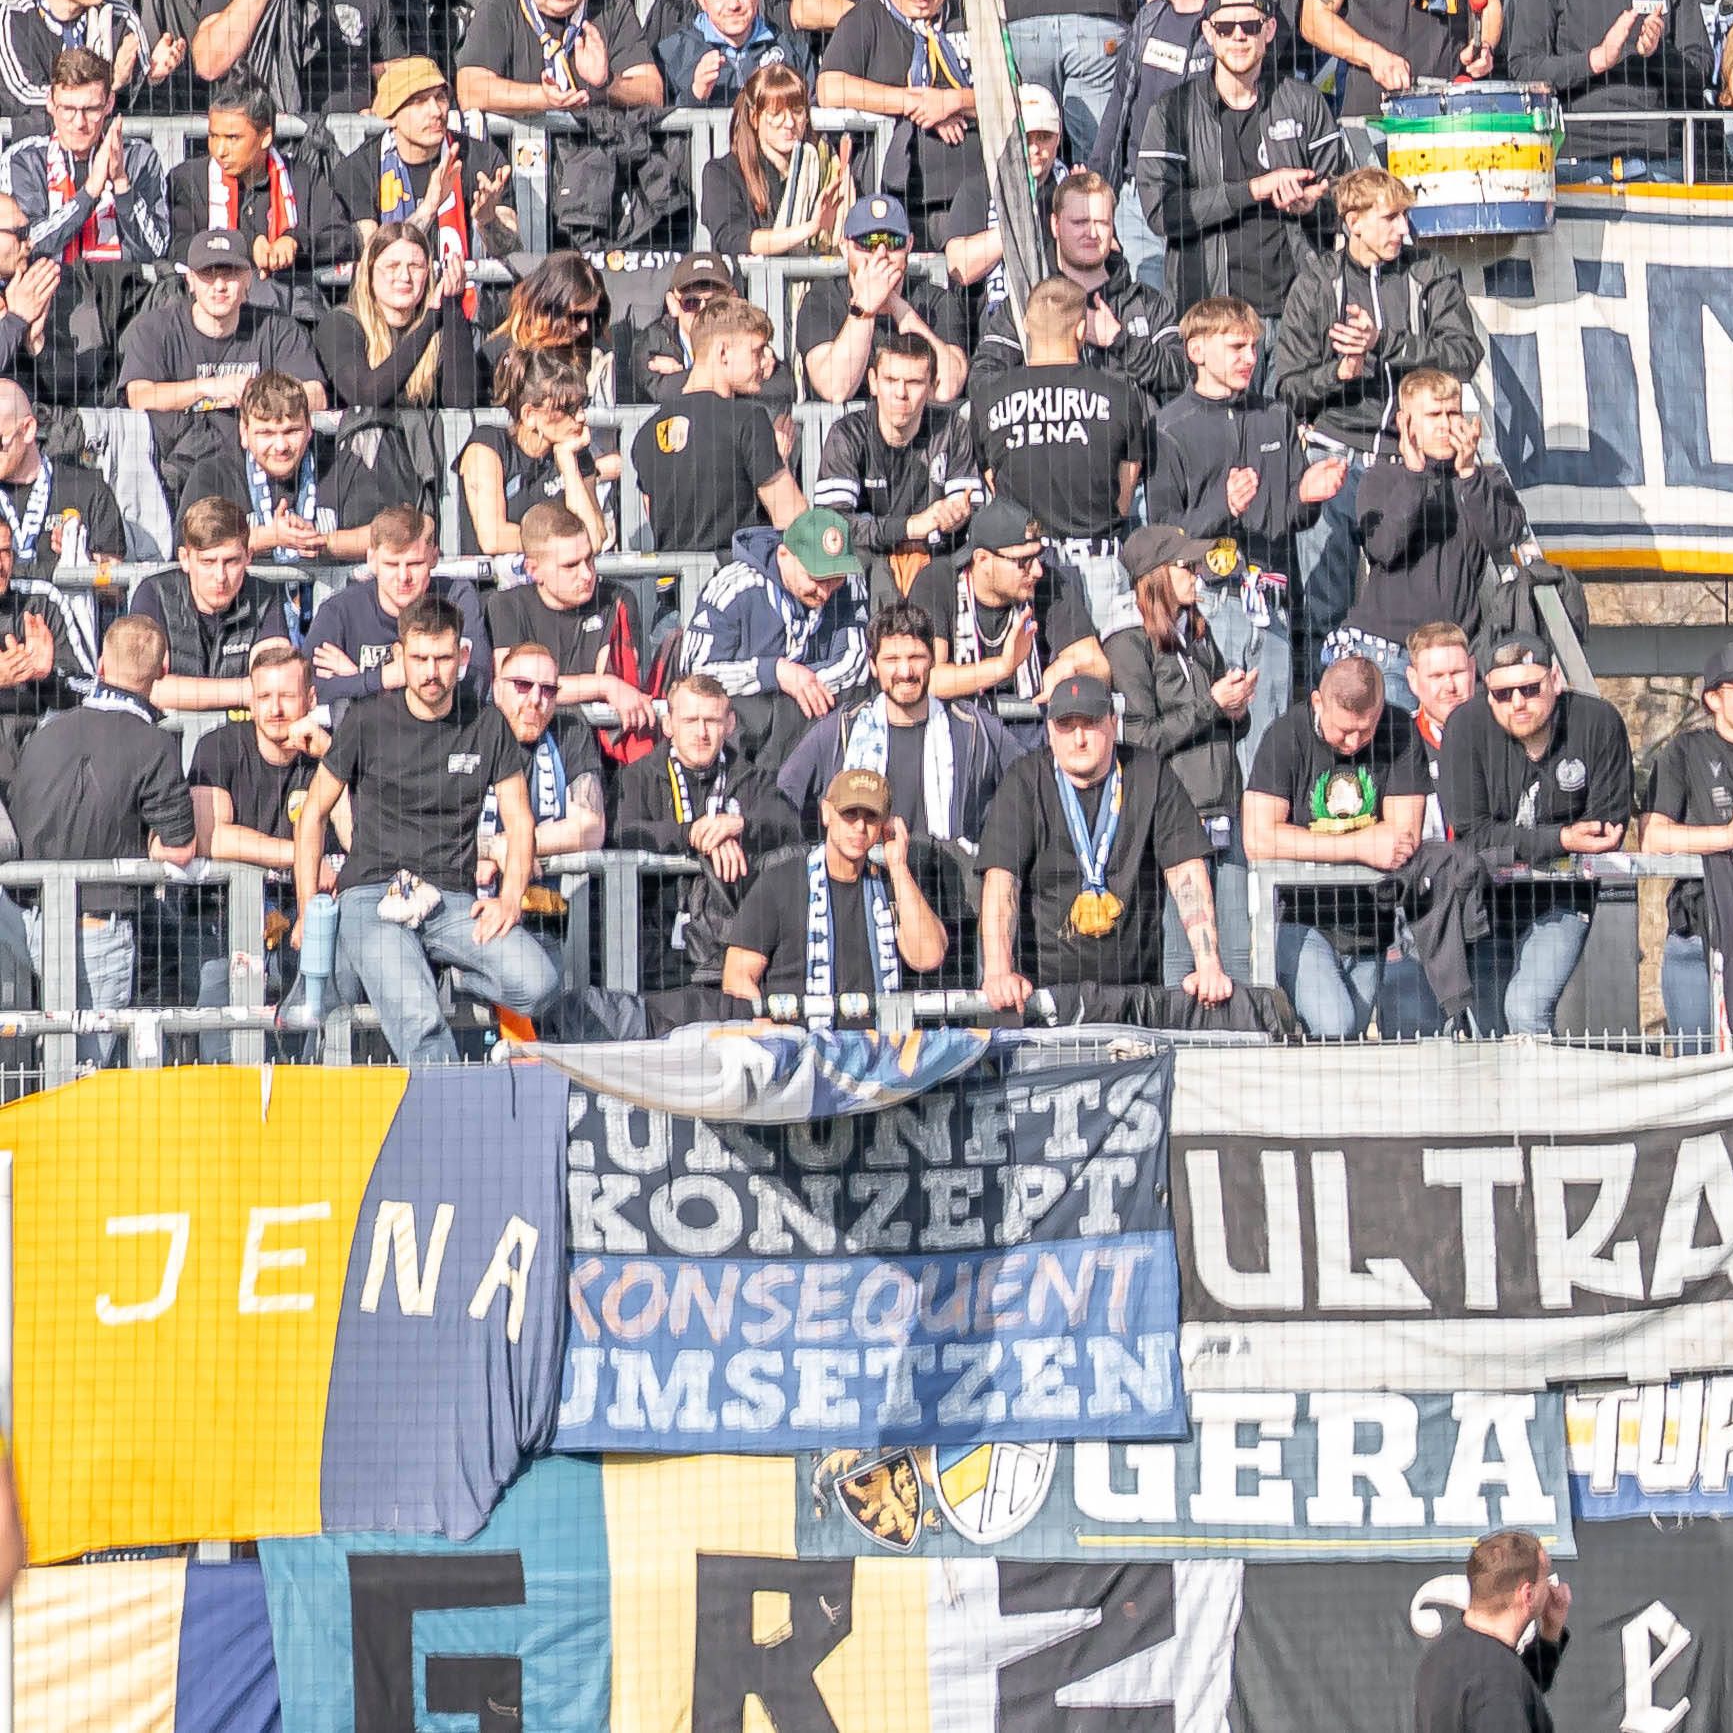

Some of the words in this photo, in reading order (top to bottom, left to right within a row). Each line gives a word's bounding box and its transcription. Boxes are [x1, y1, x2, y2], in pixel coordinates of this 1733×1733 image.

[1006, 420, 1088, 450] JENA
[567, 1155, 1138, 1256] KONZEPT
[96, 1200, 538, 1344] JENA
[568, 1246, 1154, 1348] KONSEQUENT
[1072, 1391, 1560, 1530] GERA
